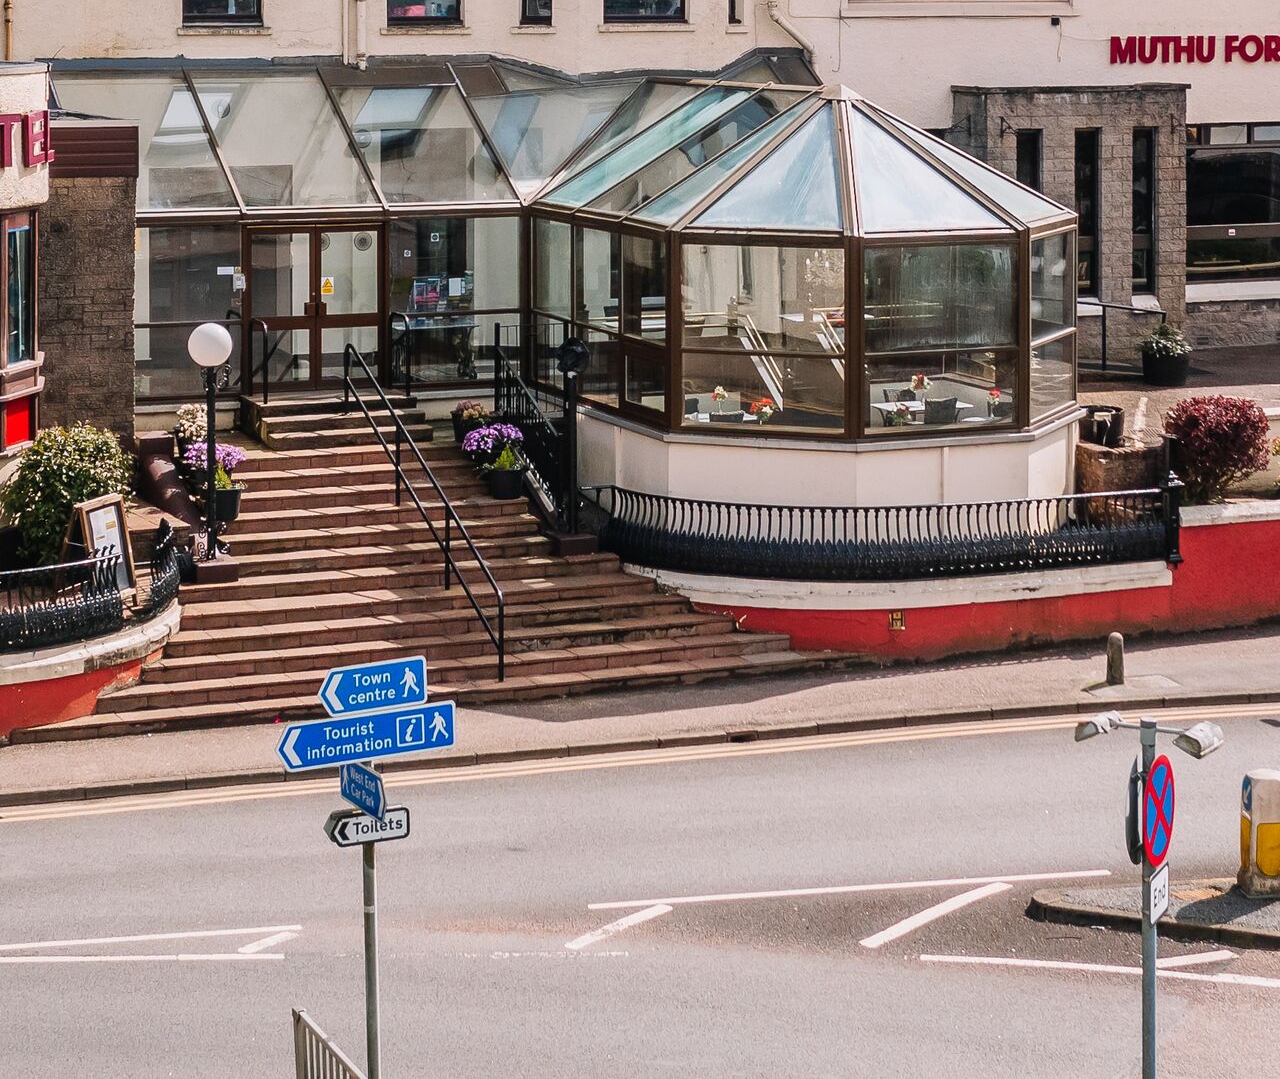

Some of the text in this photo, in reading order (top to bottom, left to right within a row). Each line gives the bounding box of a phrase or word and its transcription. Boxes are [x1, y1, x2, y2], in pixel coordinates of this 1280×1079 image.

[1110, 35, 1216, 64] MUTHU
[353, 672, 391, 687] Town
[348, 688, 396, 705] centre
[323, 722, 375, 740] Tourist
[307, 737, 392, 760] information
[350, 766, 375, 792] West End
[350, 783, 374, 808] Car Park
[353, 817, 403, 835] Toilets
